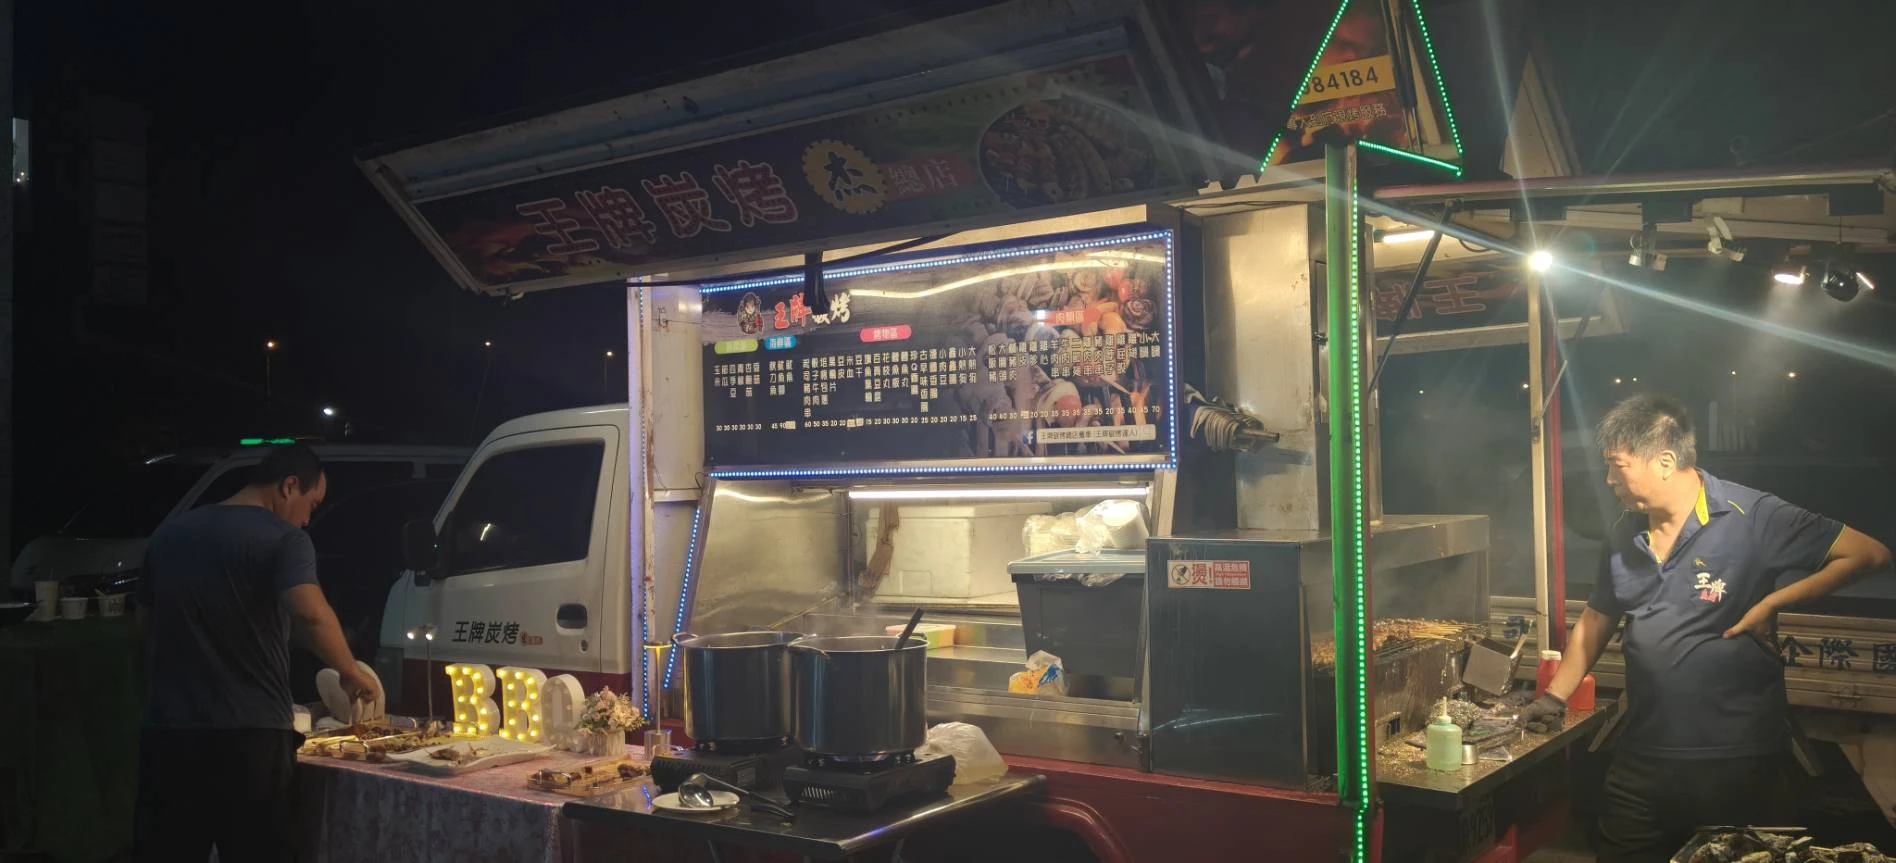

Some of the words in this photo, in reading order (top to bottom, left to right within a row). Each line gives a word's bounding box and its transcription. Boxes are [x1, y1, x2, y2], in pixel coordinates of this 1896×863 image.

[516, 159, 798, 256] 王牌炭烤
[824, 151, 877, 201] 杰
[888, 159, 958, 195] 總店
[1694, 572, 1728, 602] 王牌
[452, 620, 520, 645] 王牌炭烤
